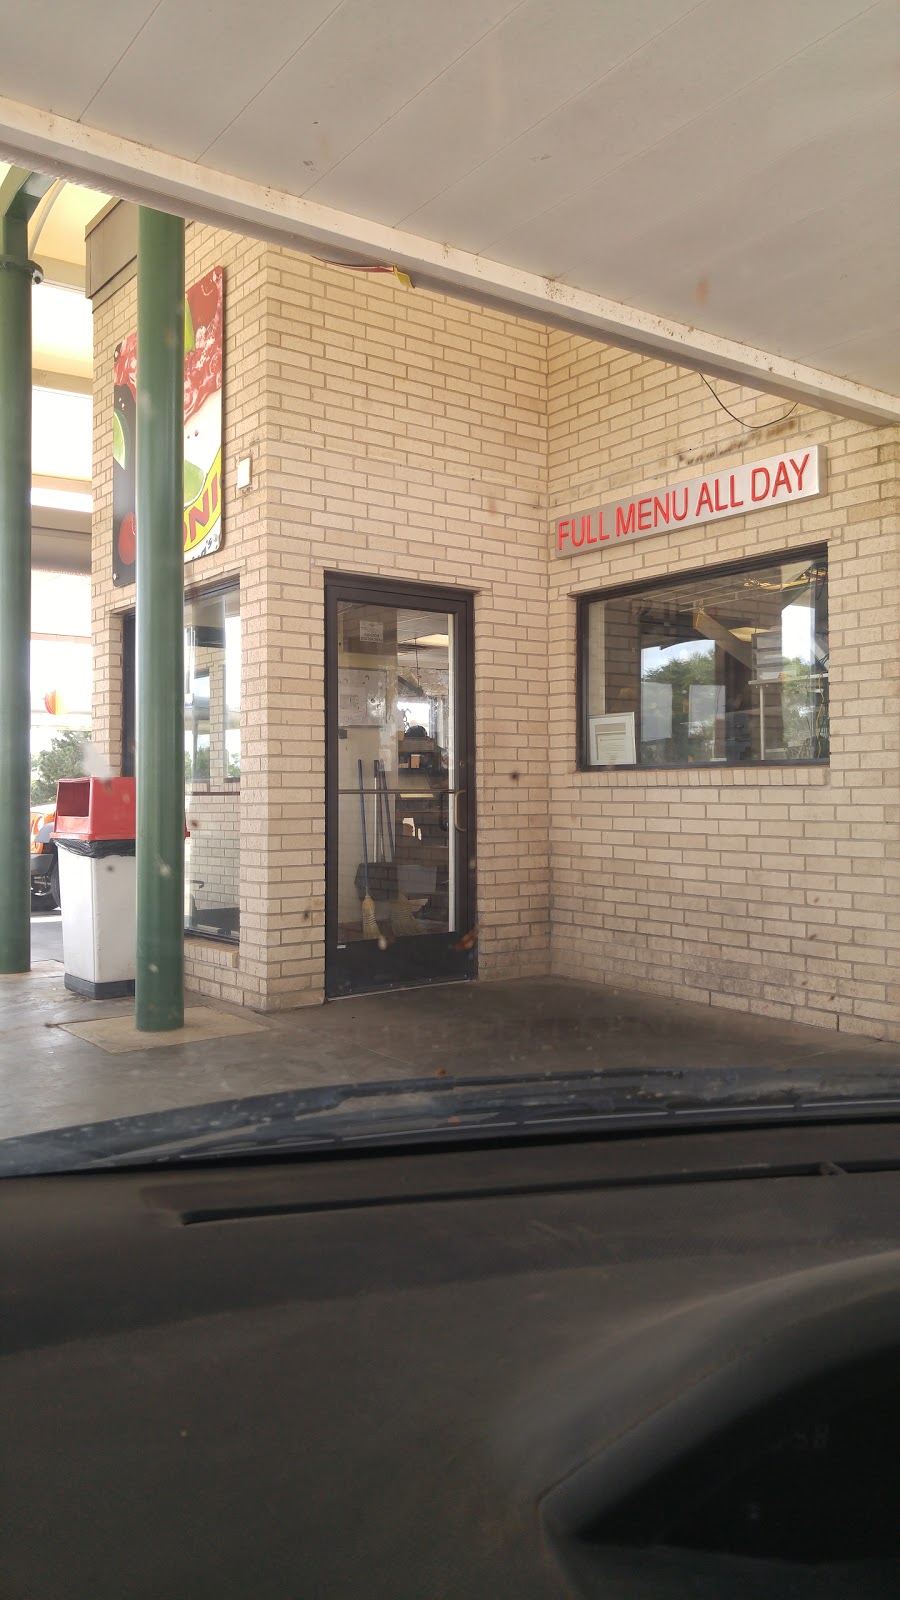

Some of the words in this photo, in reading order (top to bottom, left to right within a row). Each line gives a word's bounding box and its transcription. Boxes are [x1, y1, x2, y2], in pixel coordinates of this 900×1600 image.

[558, 511, 610, 550] FULL
[615, 487, 689, 537] MENU
[695, 475, 744, 517] ALL
[751, 453, 810, 502] DAY
